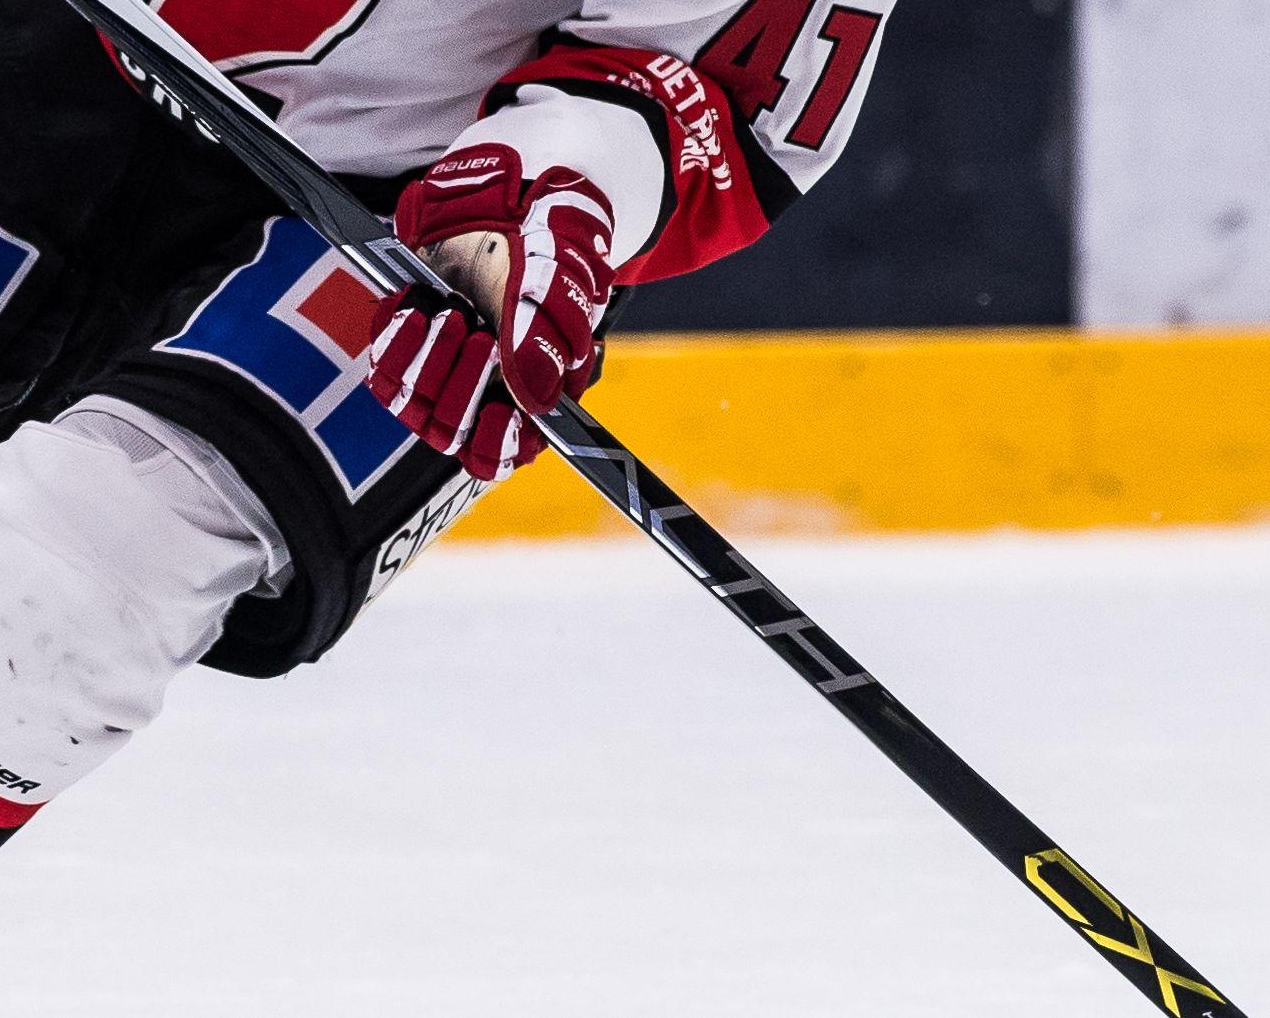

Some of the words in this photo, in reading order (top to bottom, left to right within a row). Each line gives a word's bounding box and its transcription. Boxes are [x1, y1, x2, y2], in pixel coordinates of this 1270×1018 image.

[645, 54, 707, 113] DET
[431, 156, 500, 175] BAUER
[1024, 847, 1227, 1018] CX
